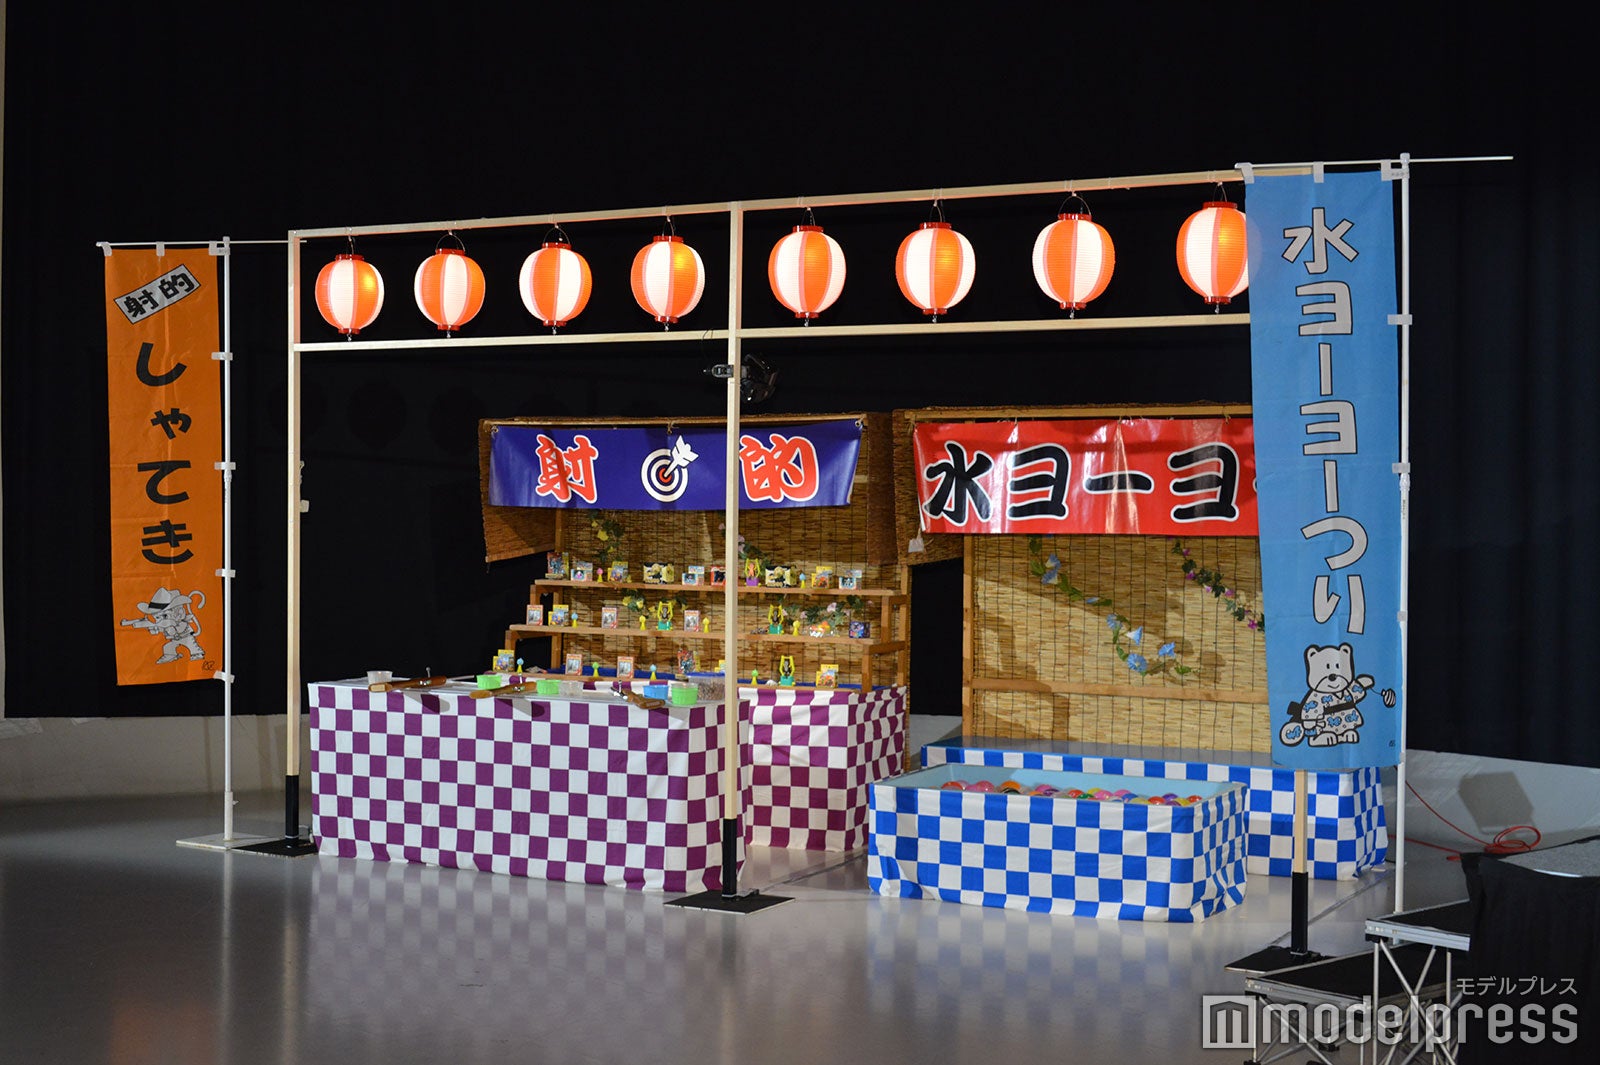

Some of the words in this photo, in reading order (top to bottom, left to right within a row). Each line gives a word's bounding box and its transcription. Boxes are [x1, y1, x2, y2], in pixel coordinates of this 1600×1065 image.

[124, 272, 196, 318] 射的
[136, 342, 194, 564] しゃてき
[922, 441, 1258, 526] 水ヨーヨ
[1282, 207, 1368, 635] 水ヨーヨーつり
